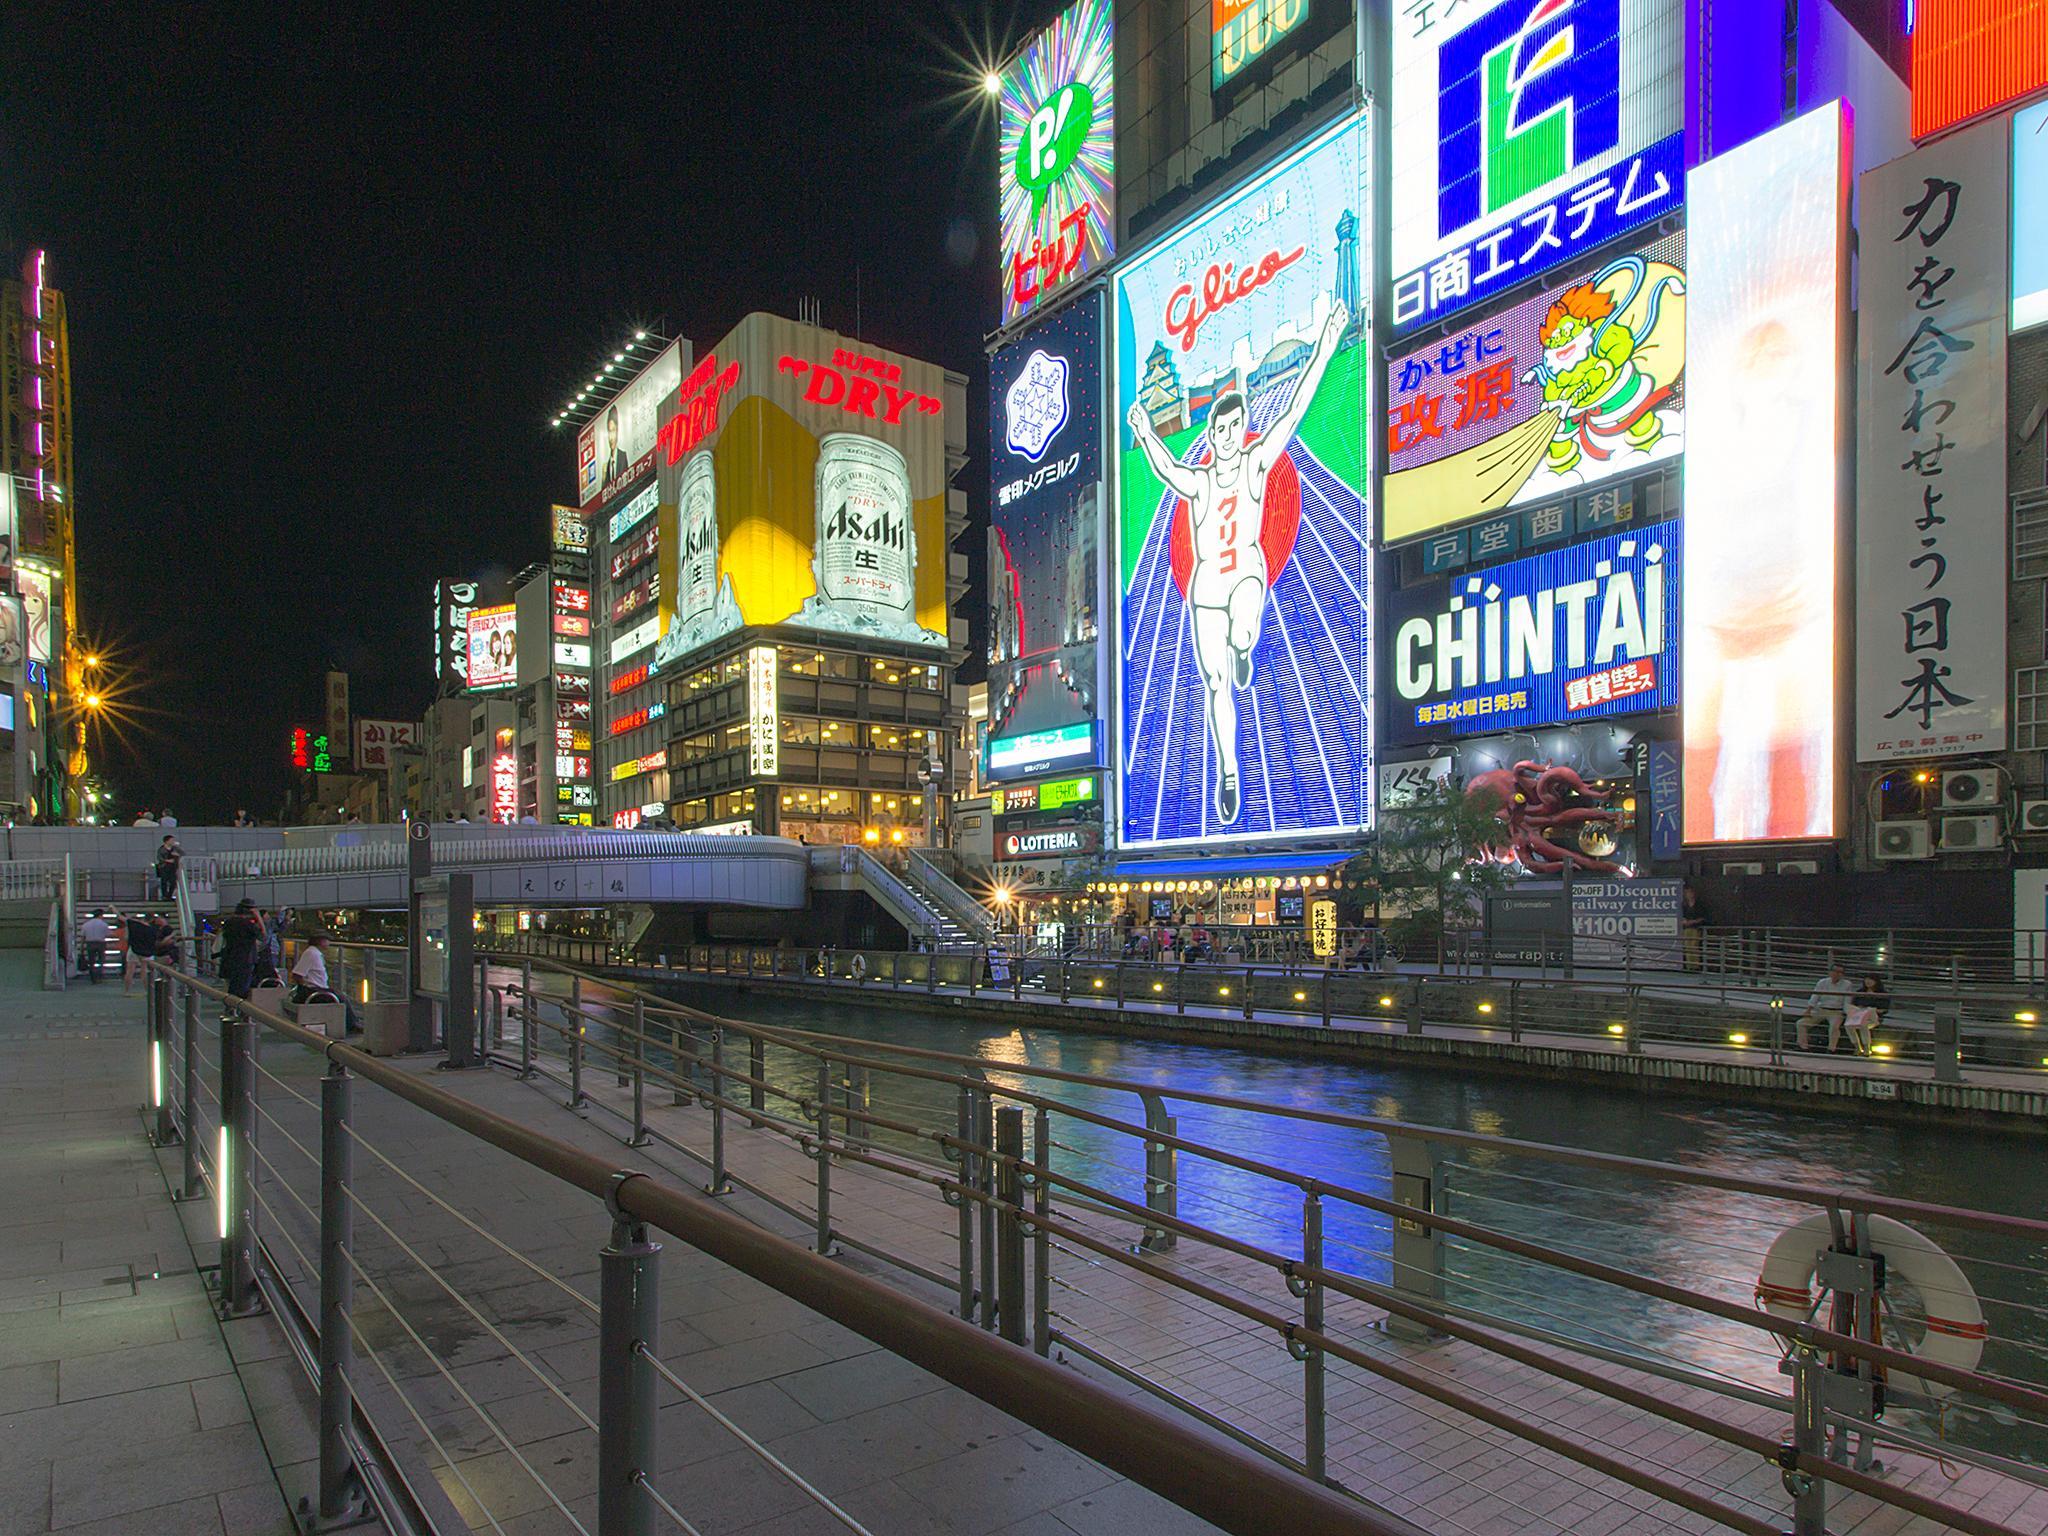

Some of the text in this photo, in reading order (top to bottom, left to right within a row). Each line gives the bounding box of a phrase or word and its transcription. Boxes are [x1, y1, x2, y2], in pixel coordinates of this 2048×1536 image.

[1014, 202, 1090, 304] ピップ
[1392, 158, 1671, 326] 日商エステム
[1165, 246, 1305, 352] Glico
[832, 347, 902, 384] SUPER
[1398, 329, 1503, 393] かぜに
[1387, 357, 1515, 455] 改源
[1884, 177, 1974, 730] 力を合わせよう日本
[998, 452, 1080, 506] 雪印メグミルク
[827, 502, 904, 552] Asahi
[1619, 508, 1631, 519] 3F
[682, 515, 713, 571] Asahi
[1217, 488, 1237, 574] グリコ
[693, 564, 702, 585] 生
[855, 550, 879, 571] 生
[843, 575, 892, 592] スーパードライ
[1611, 662, 1638, 682] 住宅
[1612, 672, 1654, 697] ニュース
[1418, 691, 1527, 723] 毎週水曜日発売
[1566, 673, 1613, 709] 賃貸
[364, 724, 409, 745] かに
[1637, 743, 1648, 776] 2F
[1006, 796, 1037, 810] アドアド
[1021, 832, 1079, 851] LOTTERIA
[1572, 898, 1678, 913] railway ticket
[1606, 884, 1677, 897] Discount
